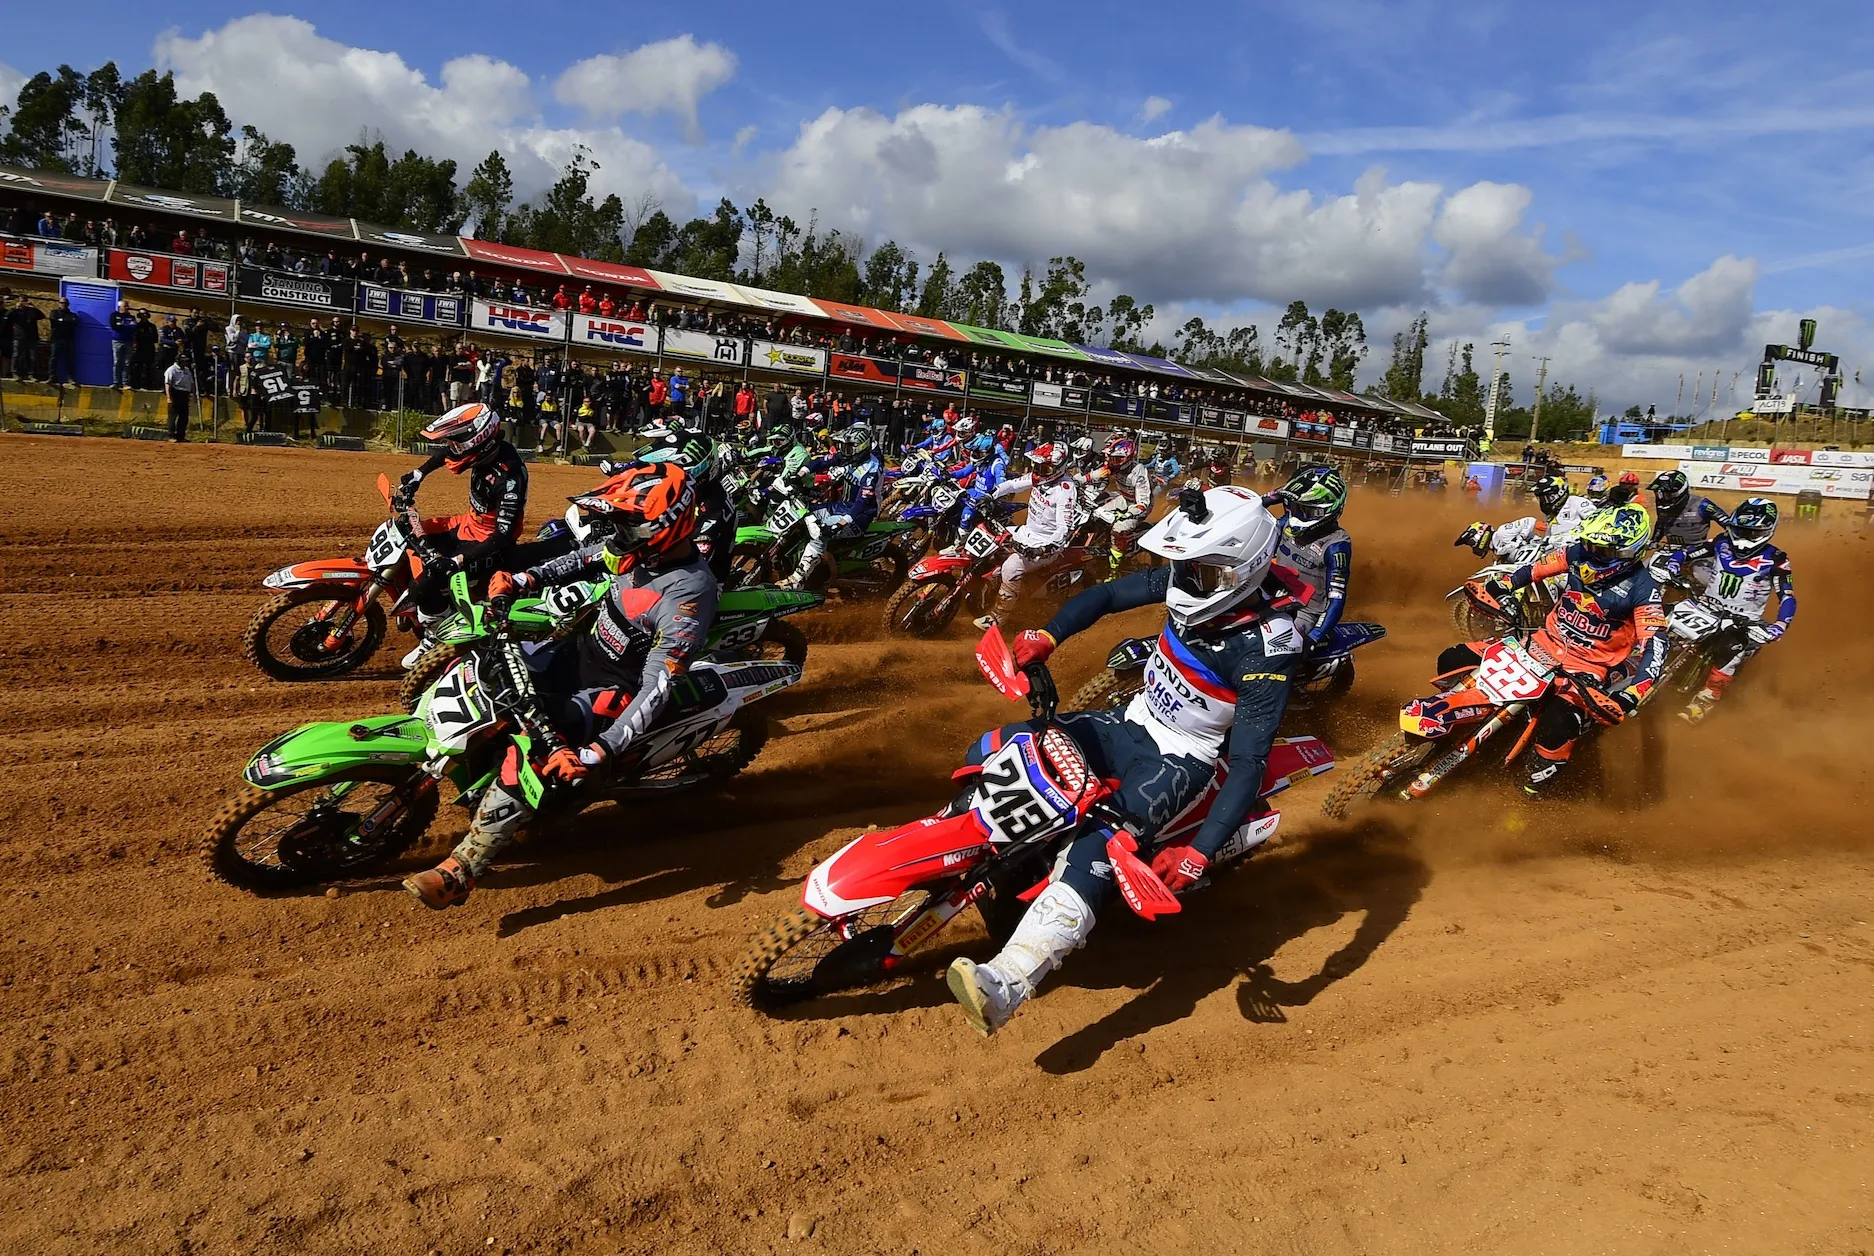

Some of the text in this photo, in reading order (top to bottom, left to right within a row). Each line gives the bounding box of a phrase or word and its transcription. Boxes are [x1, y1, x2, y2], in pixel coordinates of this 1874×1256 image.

[477, 249, 554, 266] HONDA
[263, 273, 323, 292] STANDING
[576, 267, 648, 282] HONDA
[263, 287, 331, 303] CONSTRUCT
[369, 289, 387, 299] JWR
[404, 294, 421, 304] JWR
[438, 299, 455, 308] JWR
[488, 305, 550, 333] HRC
[587, 320, 644, 347] HRC
[836, 359, 866, 373] KTM
[1786, 348, 1825, 364] FINISH
[470, 421, 499, 446] 100%
[1412, 442, 1464, 452] PITLANE OUT
[1737, 451, 1768, 460] PECOL
[1701, 475, 1726, 484] ATZ
[935, 494, 950, 506] 22
[1032, 488, 1051, 506] ONDA
[772, 507, 797, 530] 25
[368, 529, 394, 564] 99
[967, 531, 992, 553] 89
[1249, 549, 1269, 572] FOX
[1515, 549, 1534, 564] 27
[719, 613, 746, 621] Kawasaki
[774, 607, 799, 618] DUNLOP
[1558, 606, 1610, 638] ed Bull
[719, 626, 757, 650] 33
[975, 652, 1007, 694] ACERBIS
[1312, 659, 1340, 681] 21
[1480, 648, 1540, 699] 222
[1153, 652, 1211, 712] ONDA
[434, 673, 475, 724] 77
[1153, 681, 1184, 715] HSF
[1021, 740, 1037, 767] HRC
[1043, 735, 1082, 792] RENTHA
[1289, 769, 1310, 784] PIRELLI
[980, 758, 1051, 841] 243
[1255, 818, 1275, 836] MXGP
[943, 847, 980, 867] MOTUL
[813, 877, 828, 908] HONDA
[1109, 857, 1142, 911] ACERBIS
[900, 916, 937, 949] PIRELLI
